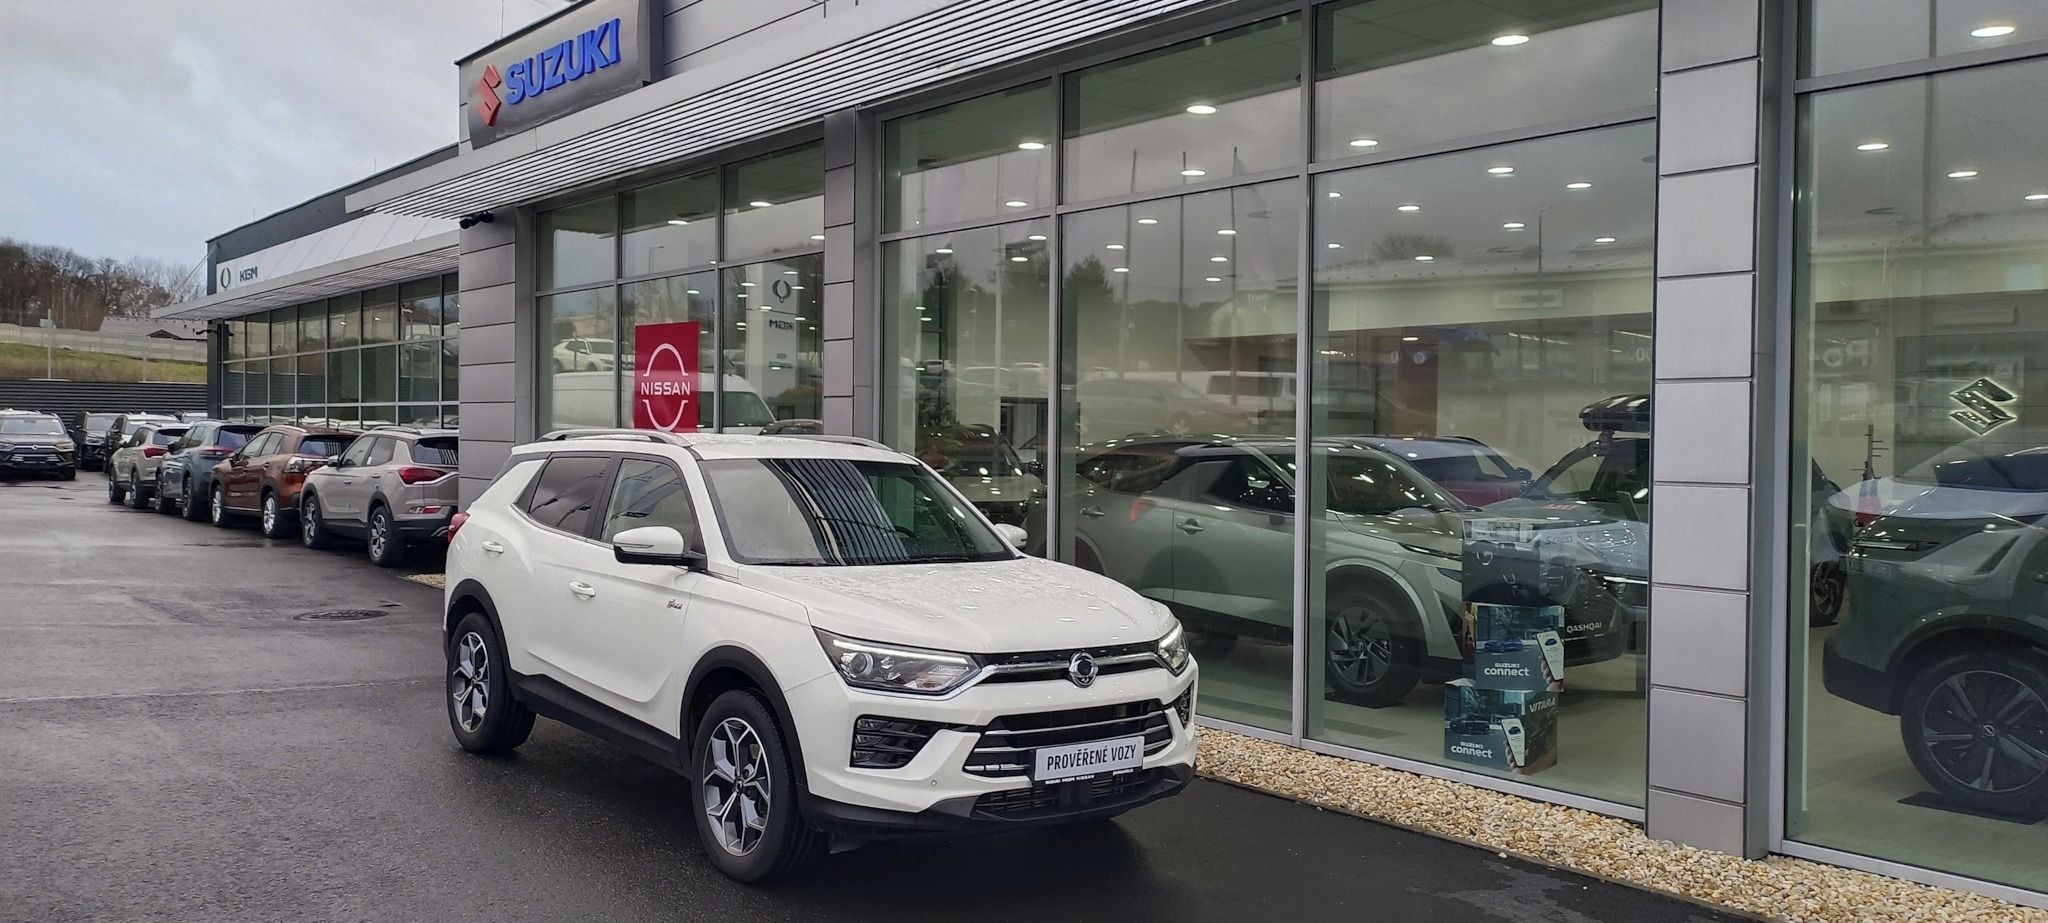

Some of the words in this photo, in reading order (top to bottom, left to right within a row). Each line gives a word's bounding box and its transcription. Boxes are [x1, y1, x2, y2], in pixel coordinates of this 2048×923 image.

[505, 18, 621, 105] SUZUKI
[240, 266, 258, 282] KGM
[641, 382, 690, 395] NISSAN
[1566, 621, 1602, 633] QASHQAI
[1484, 667, 1530, 676] connect
[1529, 697, 1556, 713] VITARA
[1047, 745, 1108, 771] PROVĚŘENÉ
[1111, 744, 1137, 761] VOZY
[1451, 745, 1493, 758] connect
